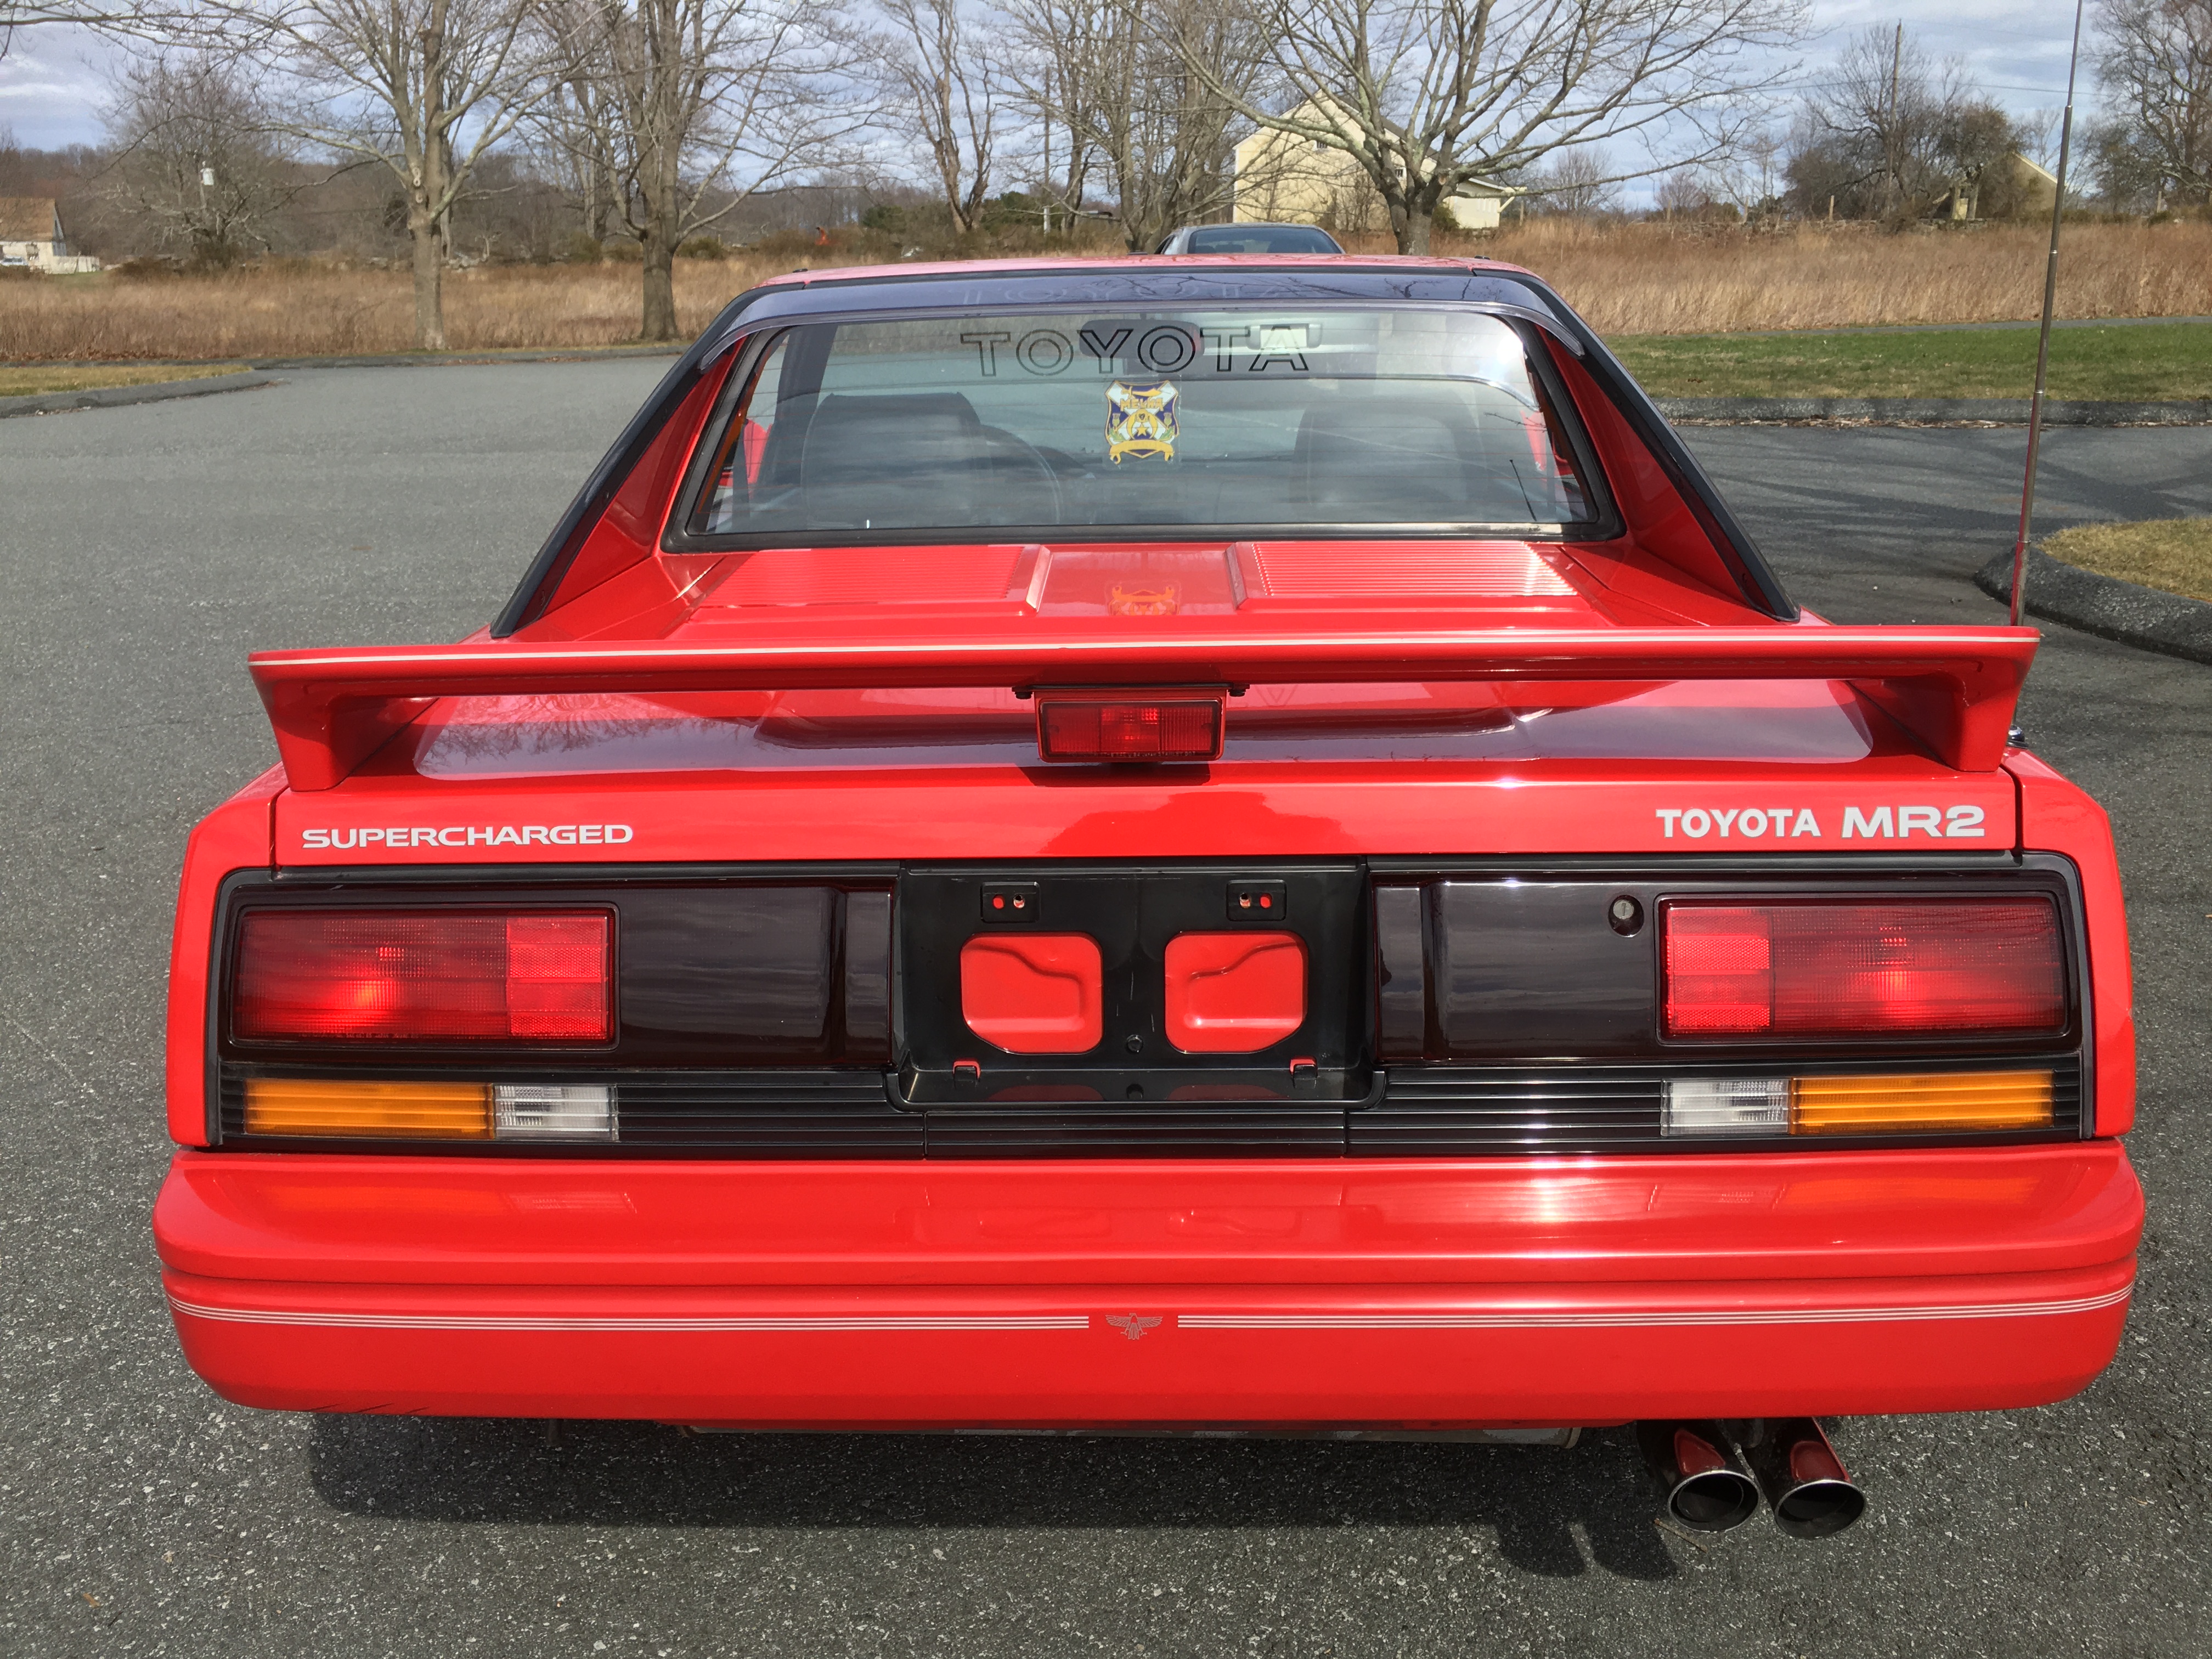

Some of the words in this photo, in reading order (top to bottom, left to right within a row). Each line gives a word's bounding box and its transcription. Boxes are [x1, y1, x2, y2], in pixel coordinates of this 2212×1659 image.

[960, 325, 1308, 376] TOYOTA
[302, 825, 633, 849] SUPERCHARGED
[1655, 808, 1821, 838] TOYOTA
[1841, 805, 1985, 838] MR2
